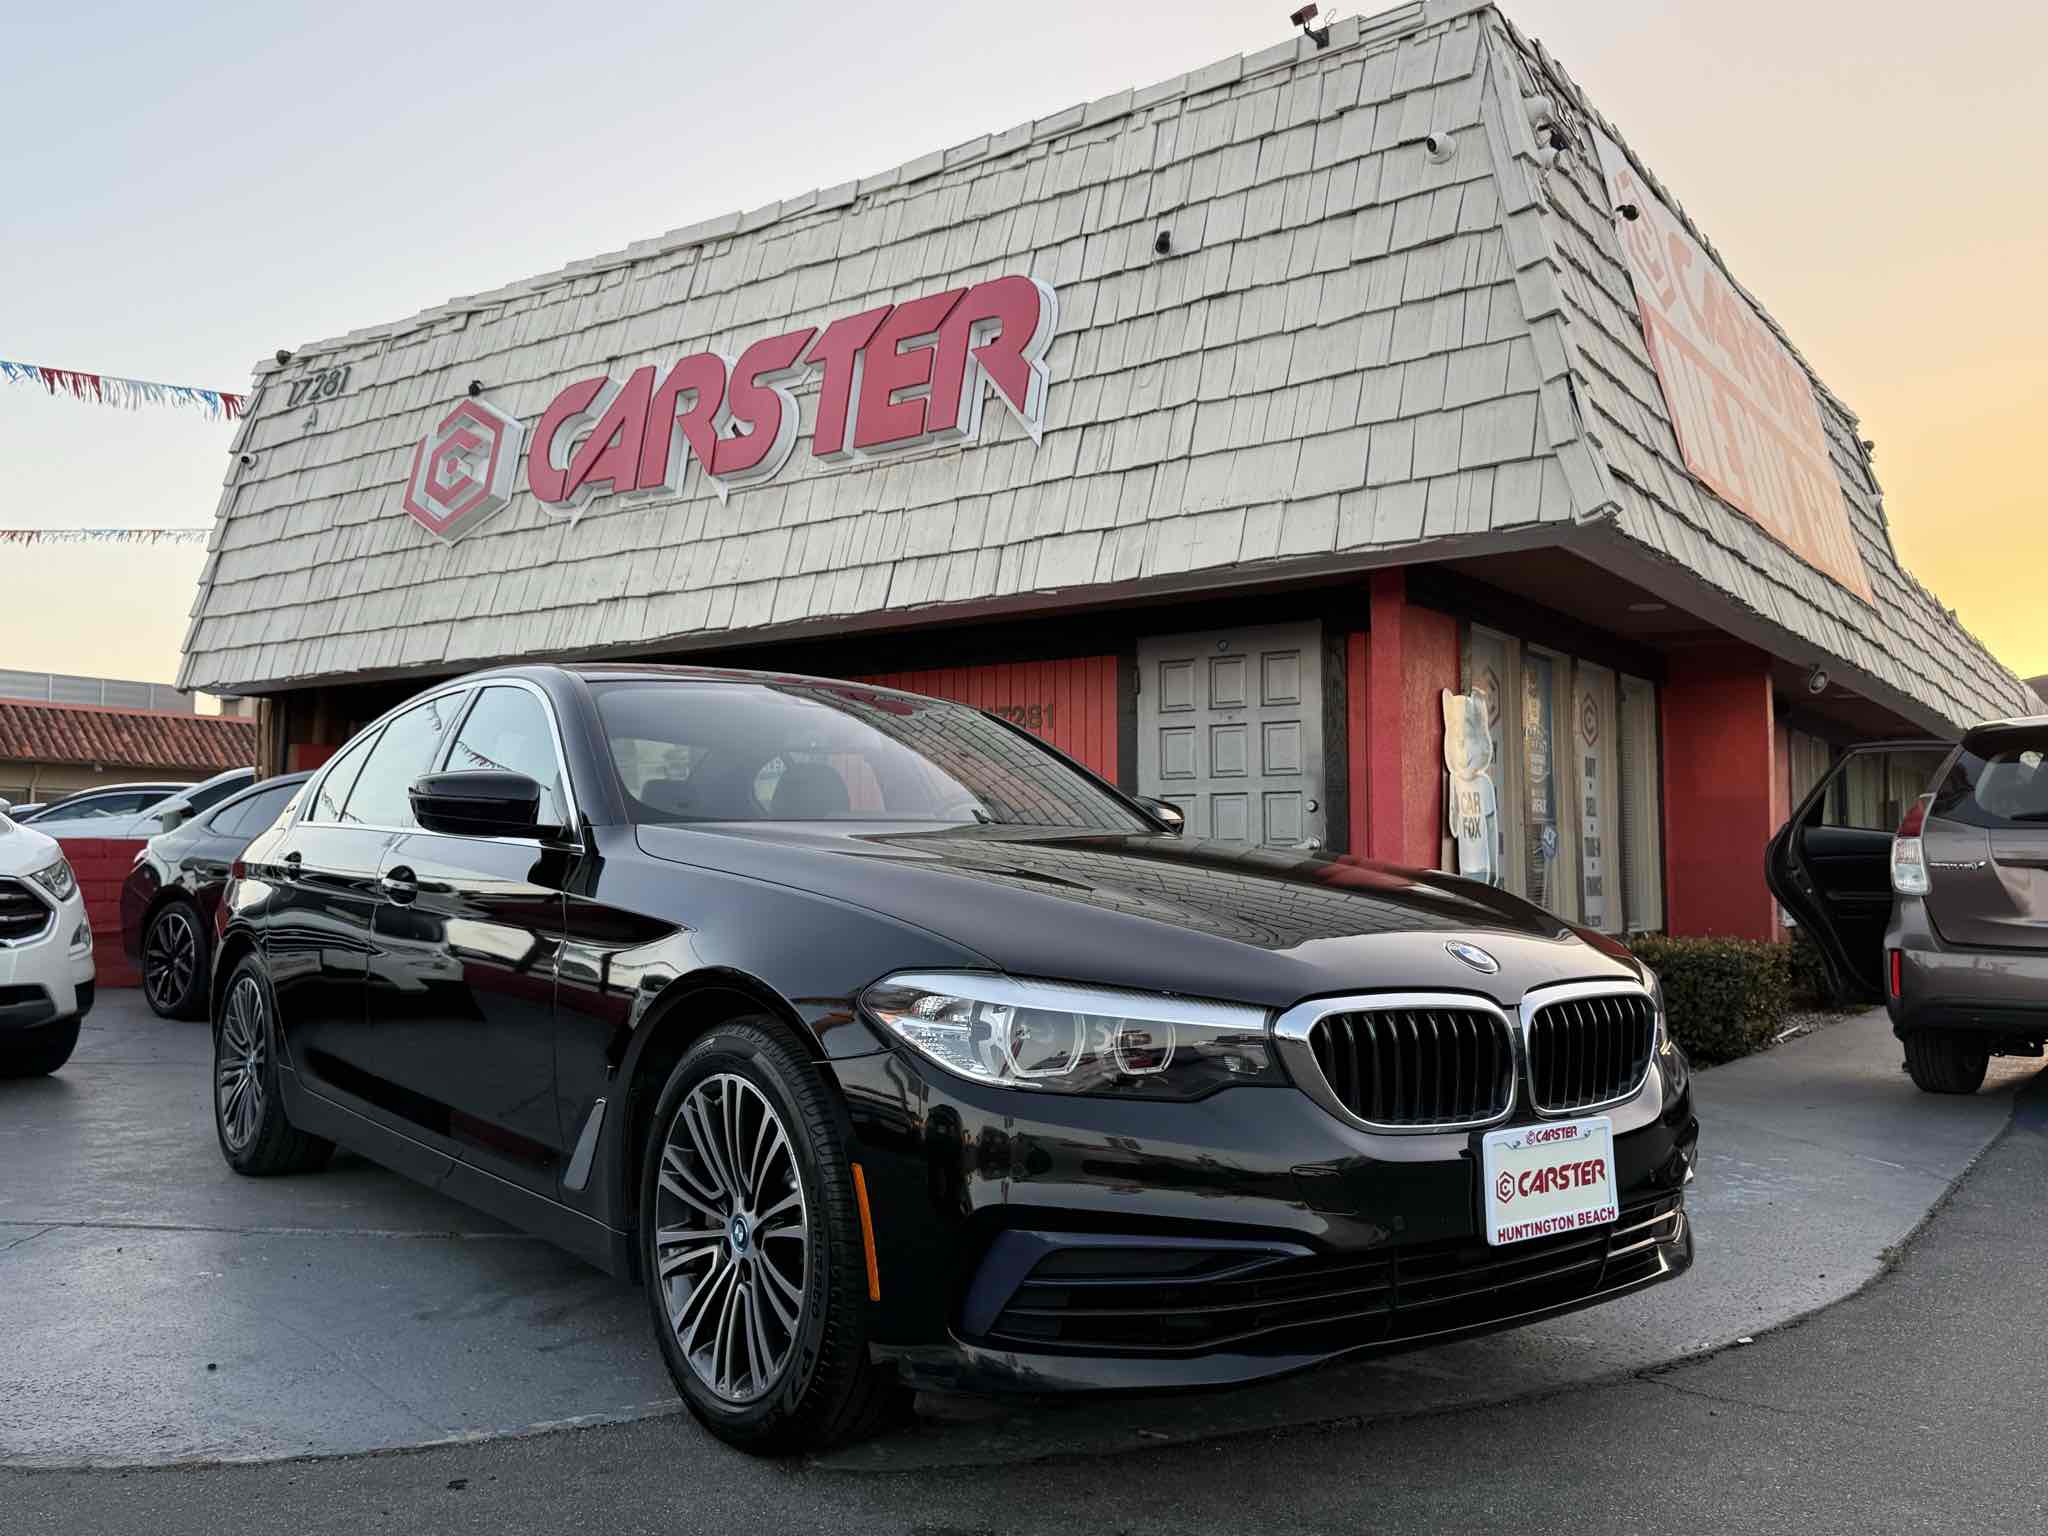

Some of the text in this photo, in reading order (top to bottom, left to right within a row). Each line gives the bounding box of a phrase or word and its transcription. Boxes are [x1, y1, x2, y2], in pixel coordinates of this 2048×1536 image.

[287, 366, 351, 407] 17281
[527, 274, 1046, 505] CARSTER
[1461, 791, 1481, 815] CAR
[1463, 816, 1481, 839] FOX
[1535, 1126, 1577, 1143] CARSTER
[1518, 1159, 1605, 1196] CARSTER
[1497, 1207, 1615, 1243] HUNTINGTON BEACH
